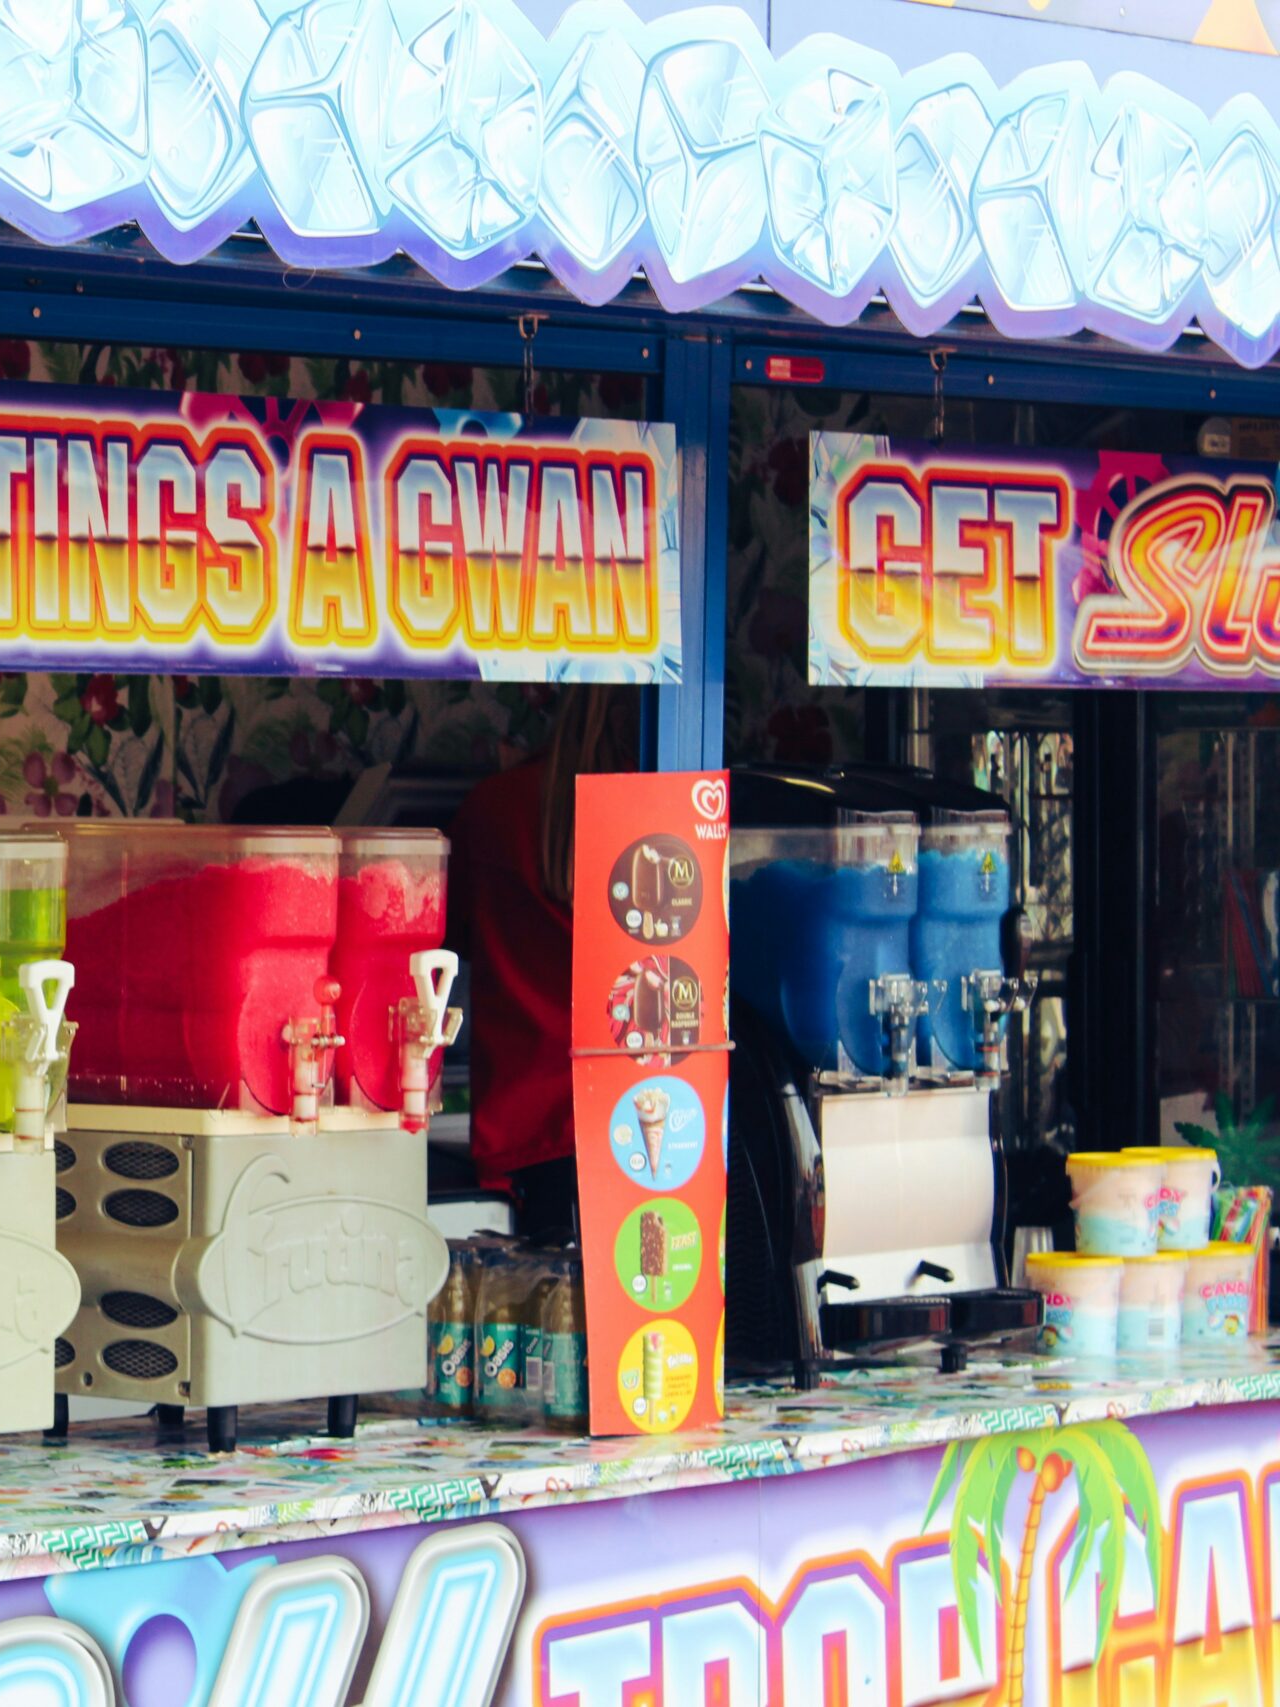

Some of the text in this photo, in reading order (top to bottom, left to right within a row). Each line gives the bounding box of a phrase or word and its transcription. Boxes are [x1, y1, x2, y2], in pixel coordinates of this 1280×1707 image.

[289, 433, 378, 648] A
[386, 438, 661, 653] GWAN
[837, 463, 1071, 668] GET
